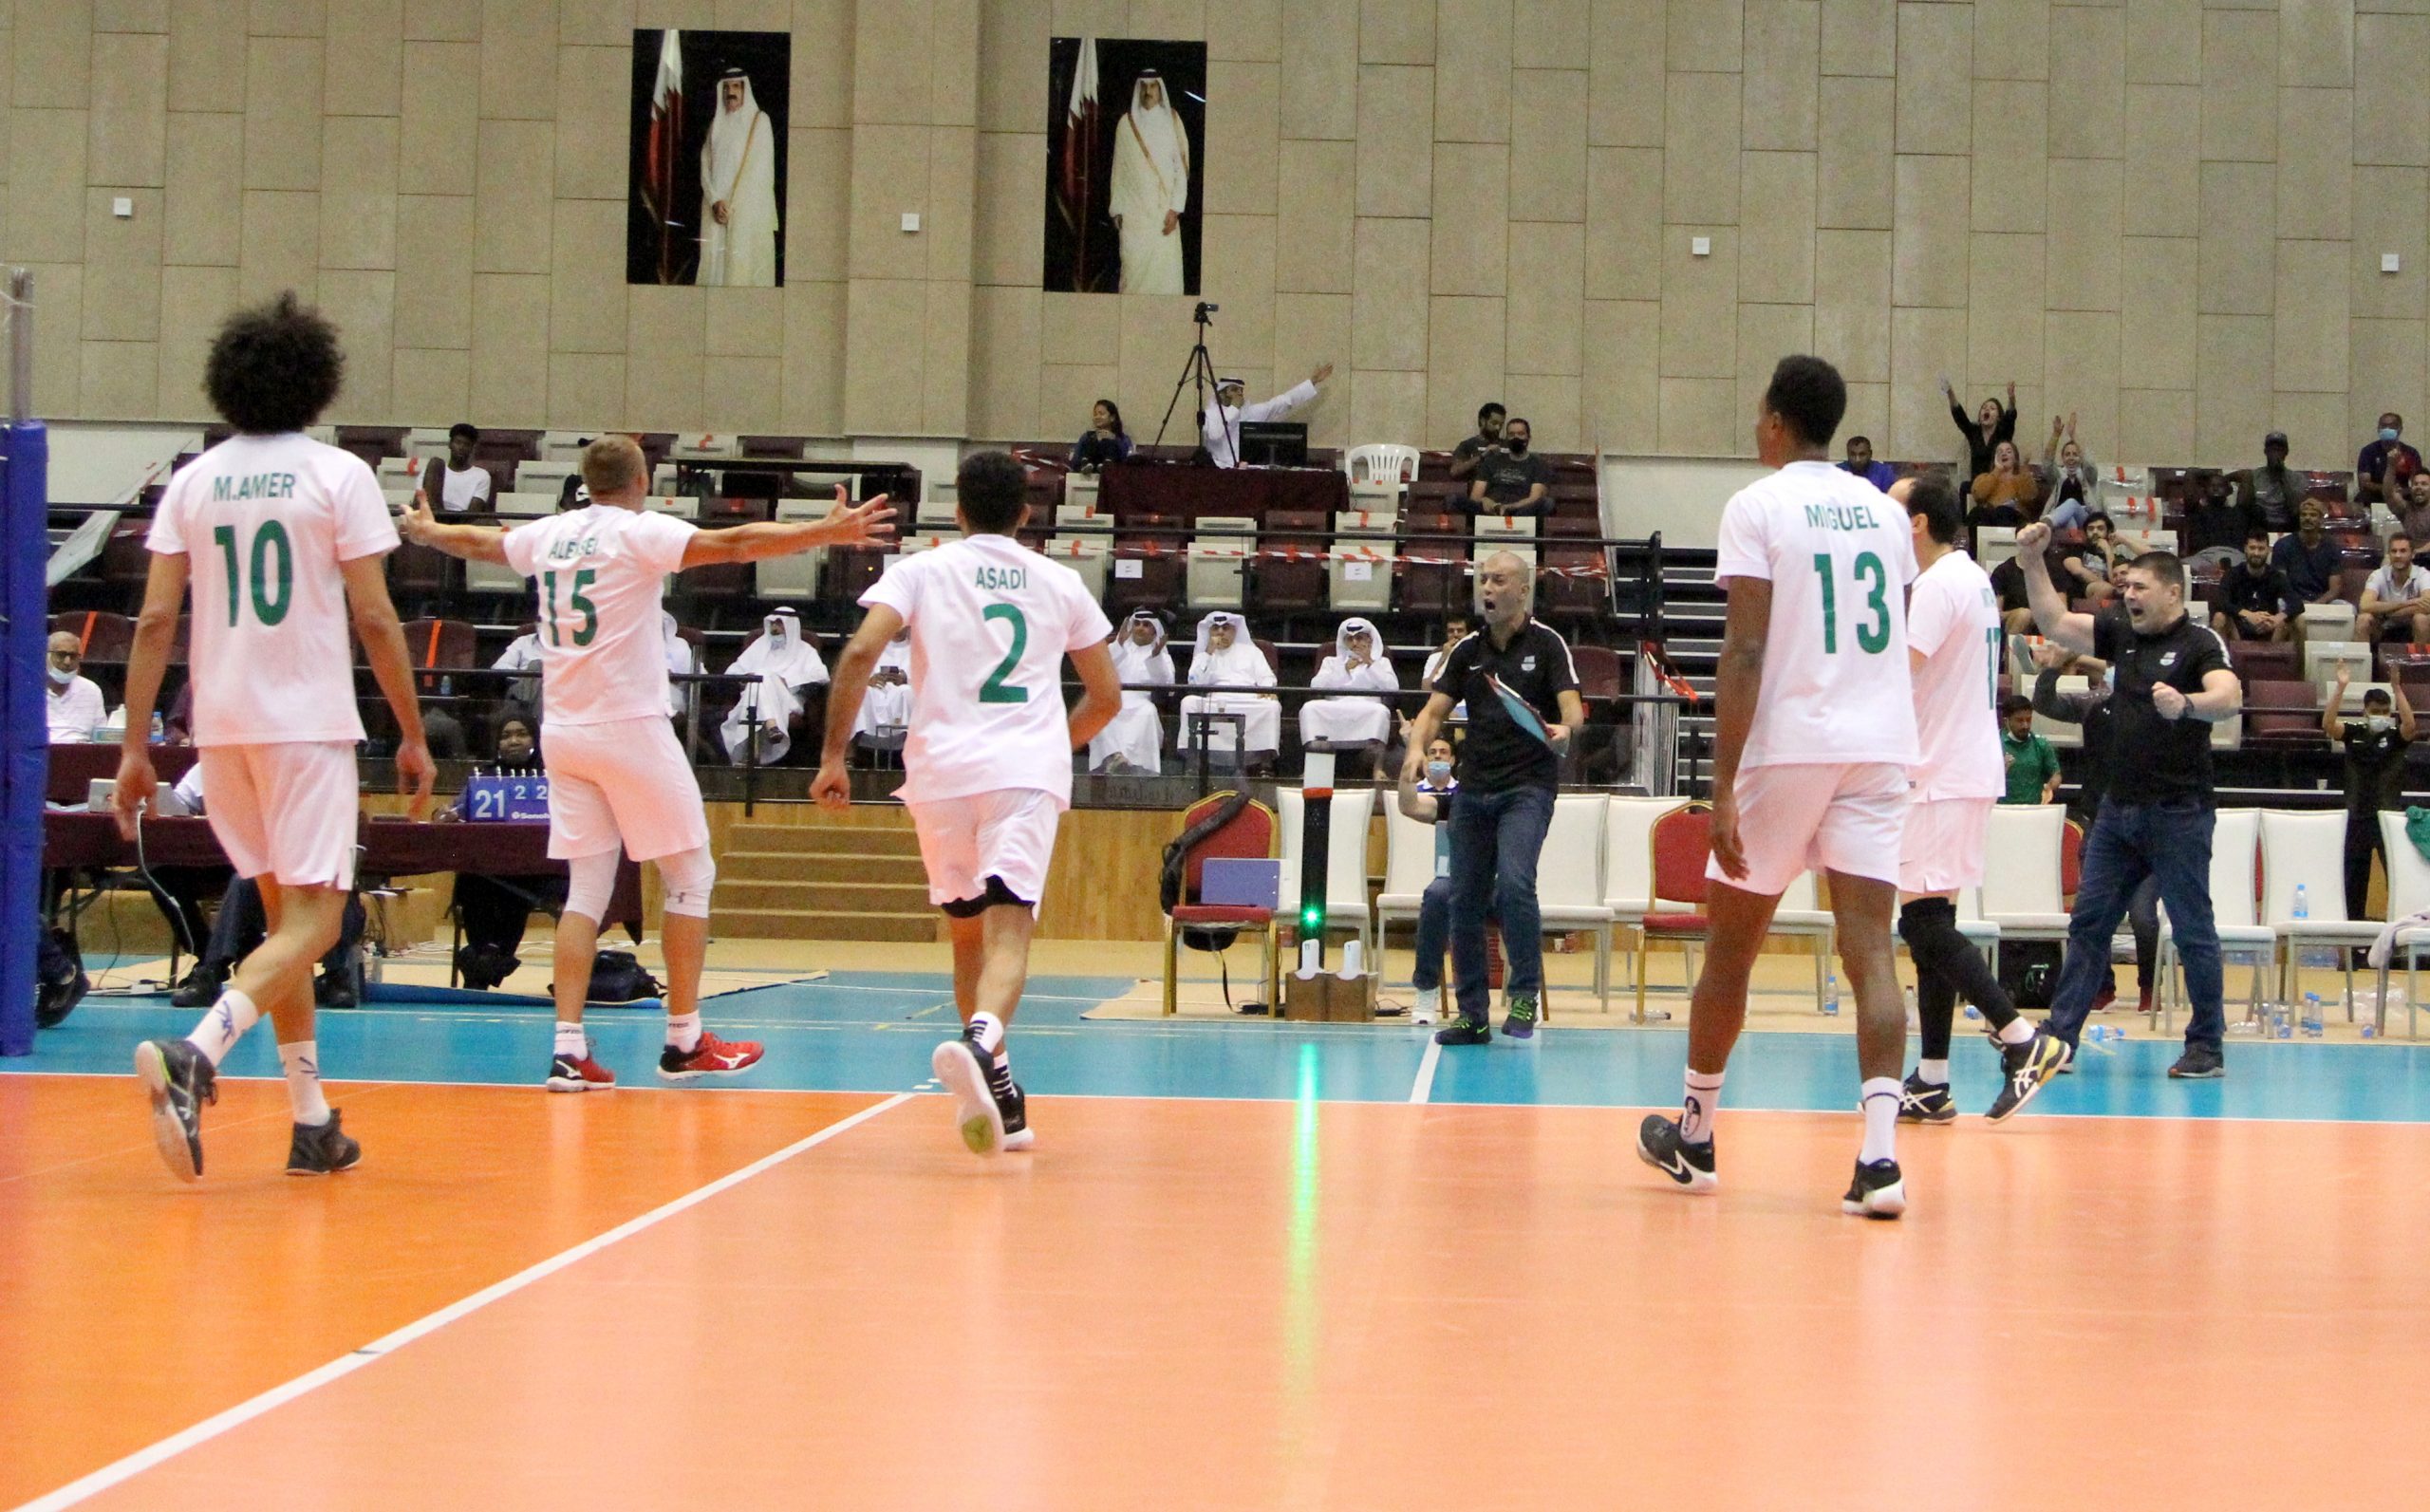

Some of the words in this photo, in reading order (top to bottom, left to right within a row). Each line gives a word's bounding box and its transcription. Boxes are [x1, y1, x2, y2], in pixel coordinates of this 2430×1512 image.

[214, 472, 295, 502] M.AMER
[1804, 504, 1879, 531] MIGUEL
[214, 519, 293, 627] 10
[976, 567, 1027, 589] ASADI
[544, 569, 598, 646] 15
[1813, 551, 1890, 654] 13
[979, 603, 1028, 702] 2
[475, 789, 505, 818] 21
[514, 784, 527, 800] 2
[535, 784, 548, 800] 2
